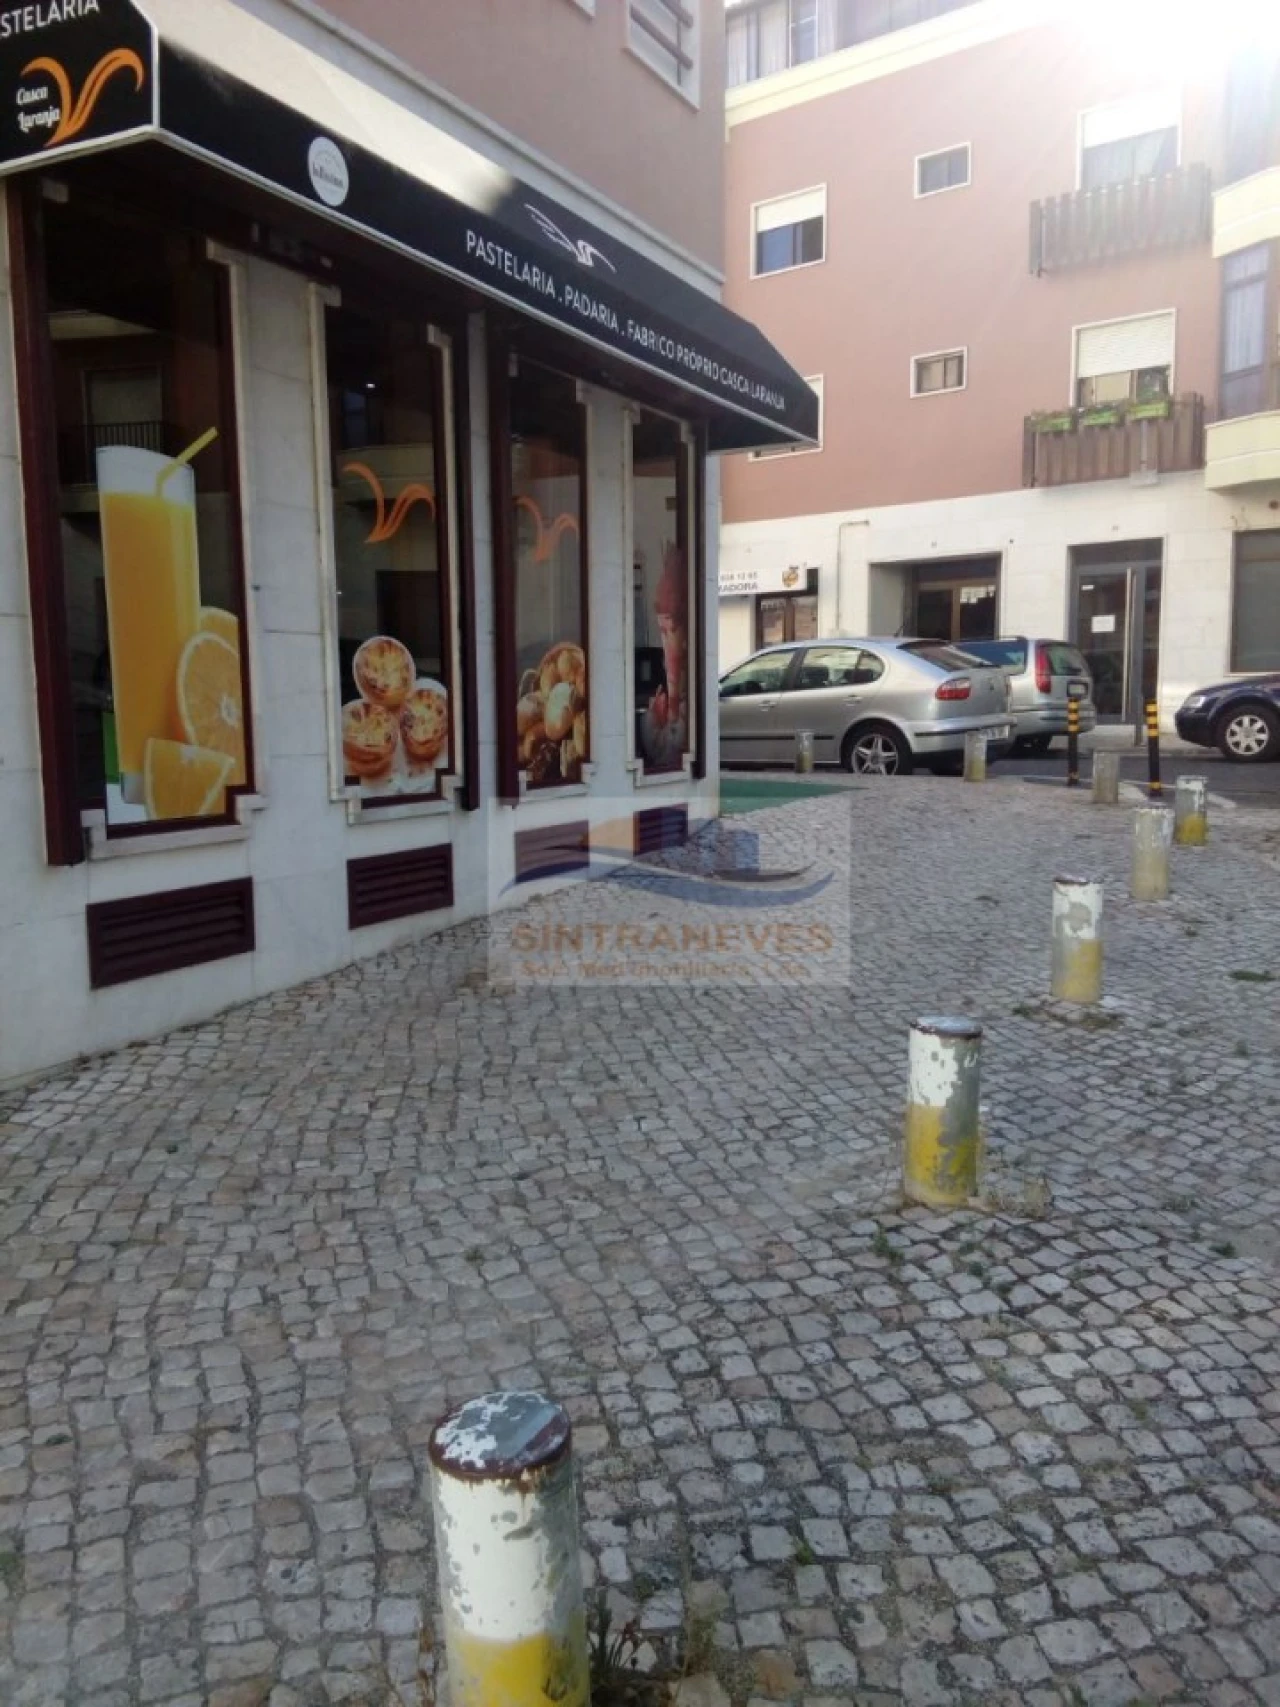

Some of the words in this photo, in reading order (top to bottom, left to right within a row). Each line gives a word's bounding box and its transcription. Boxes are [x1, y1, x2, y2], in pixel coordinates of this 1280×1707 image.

[466, 229, 555, 299] PASTELARIA
[565, 284, 619, 333] PADARIA
[627, 319, 674, 359] FABRICO
[720, 367, 749, 394] CASCA
